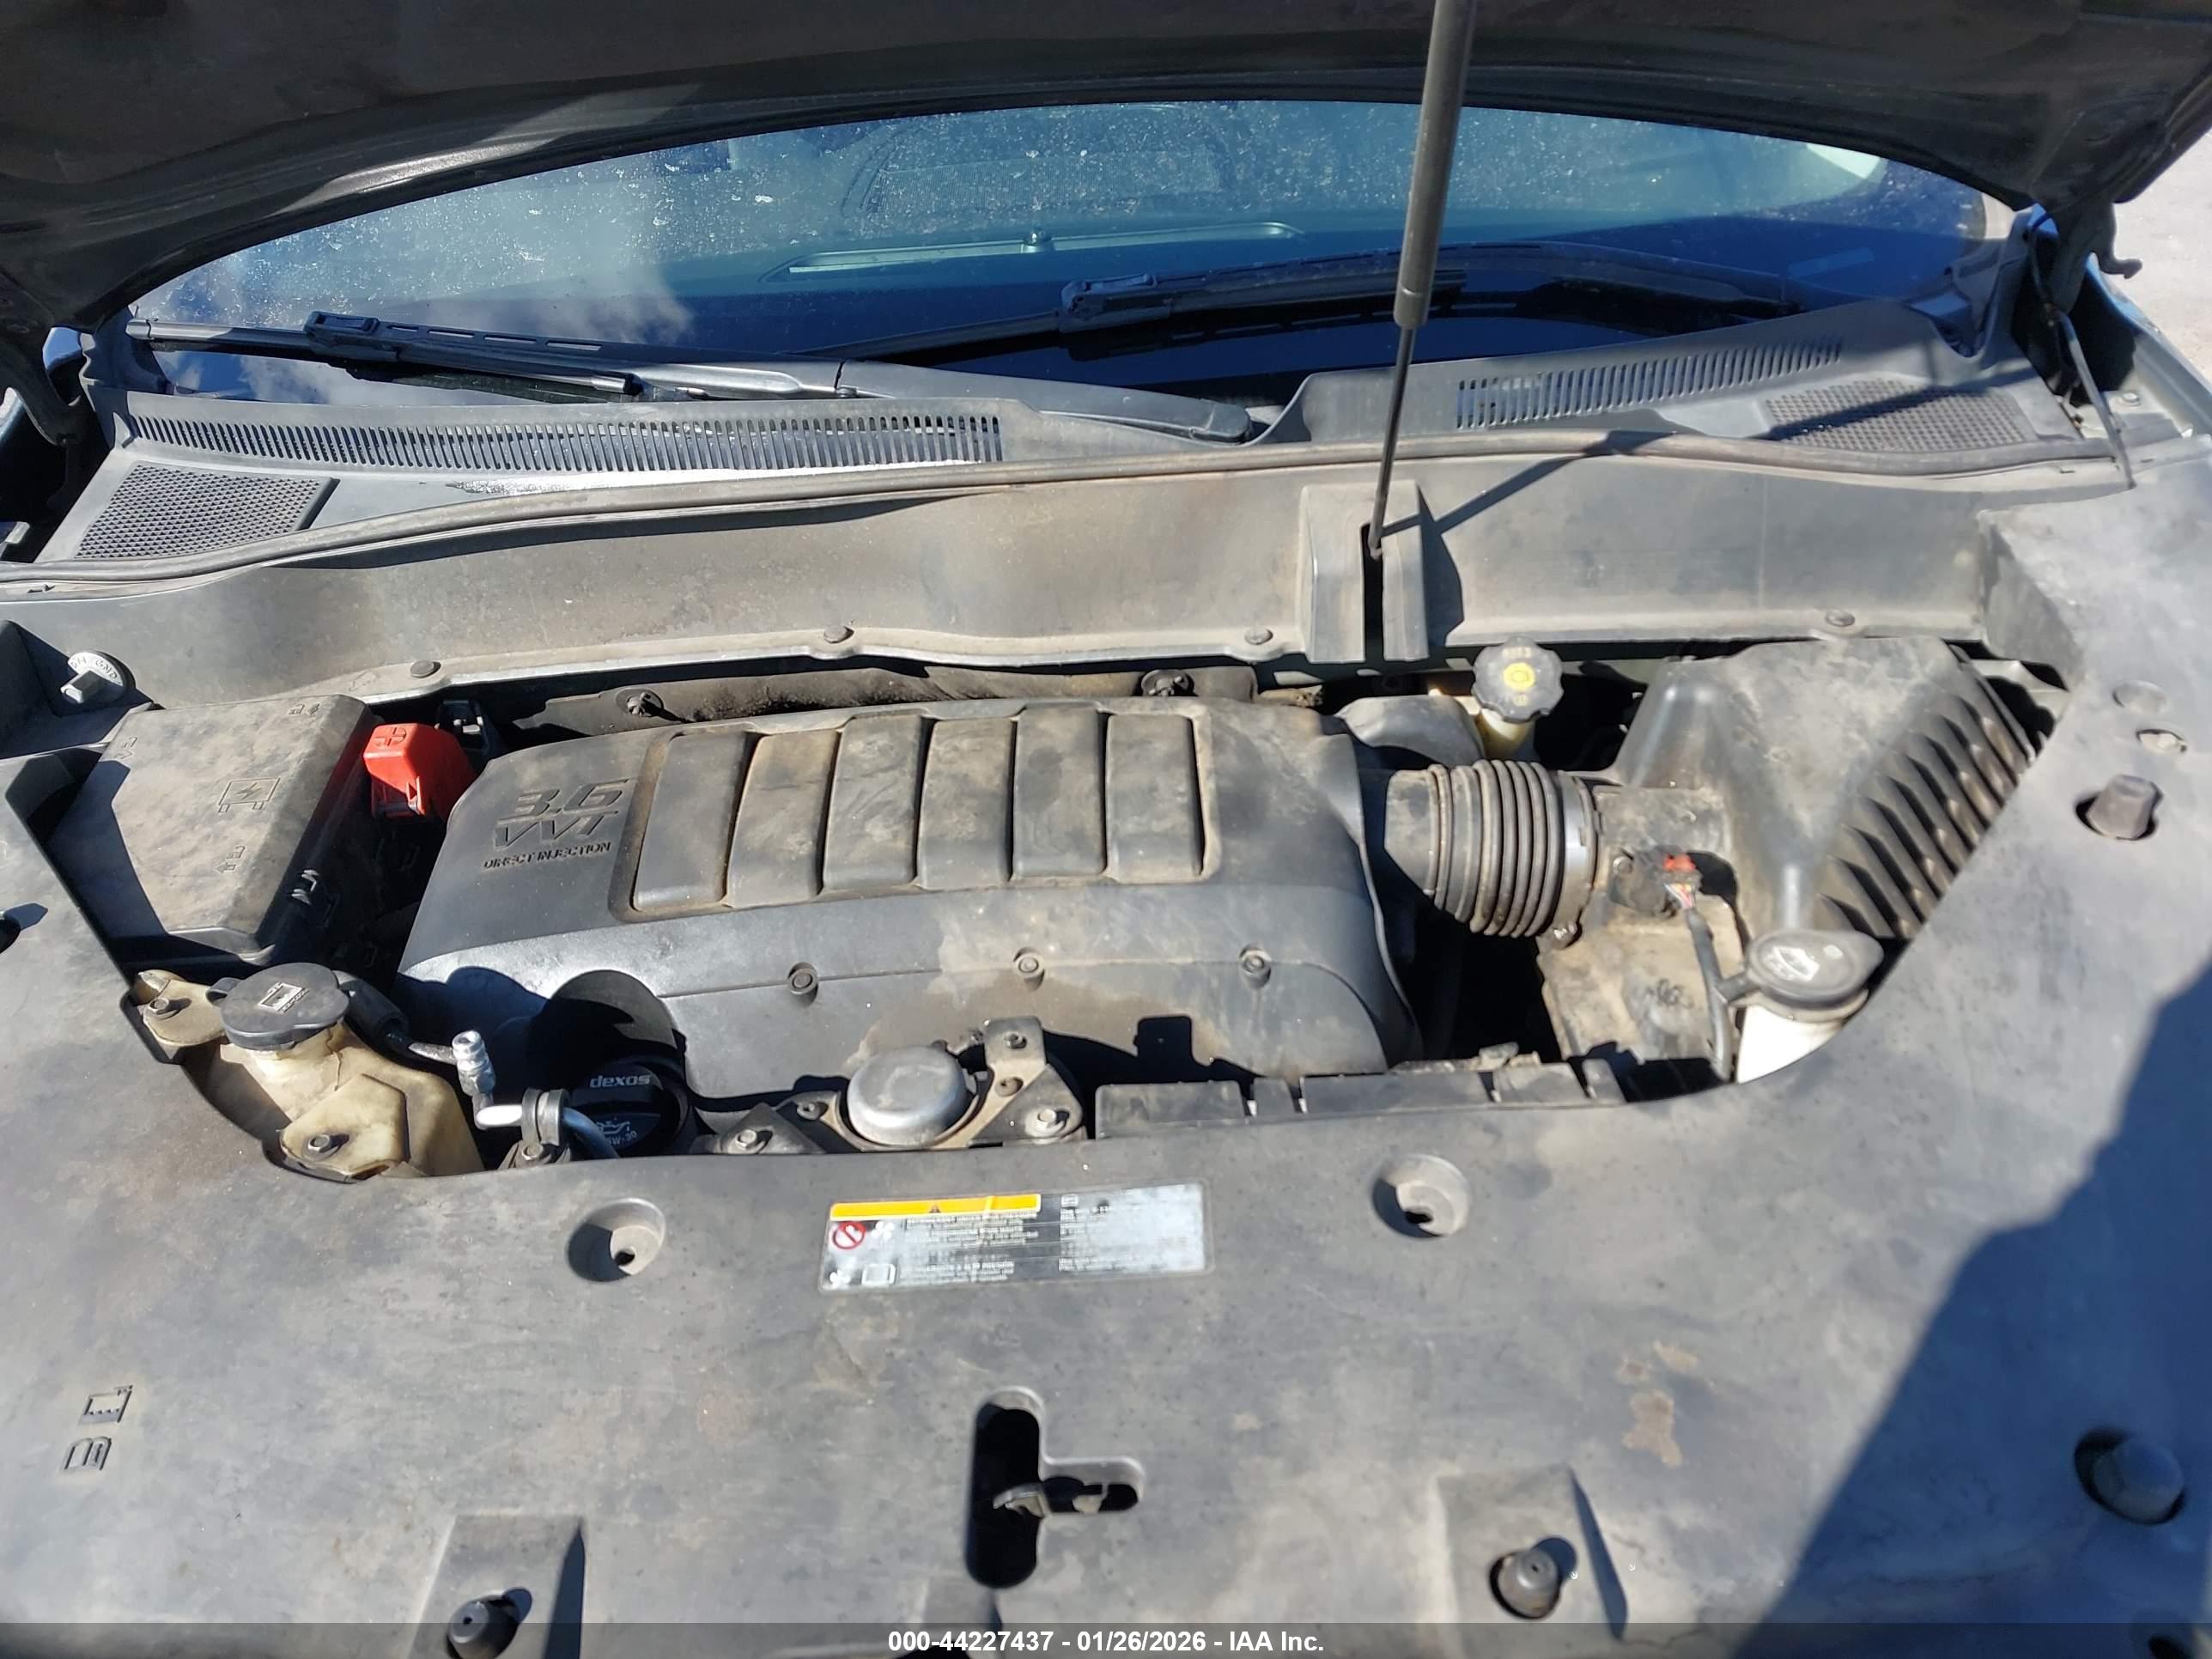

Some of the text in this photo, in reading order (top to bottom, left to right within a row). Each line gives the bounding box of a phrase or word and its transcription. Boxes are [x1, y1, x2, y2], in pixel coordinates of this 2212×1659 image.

[514, 778, 629, 816] 3.6
[494, 810, 619, 851] VVT
[483, 842, 612, 870] DIRECT INJECTION
[589, 1075, 651, 1089] dexos
